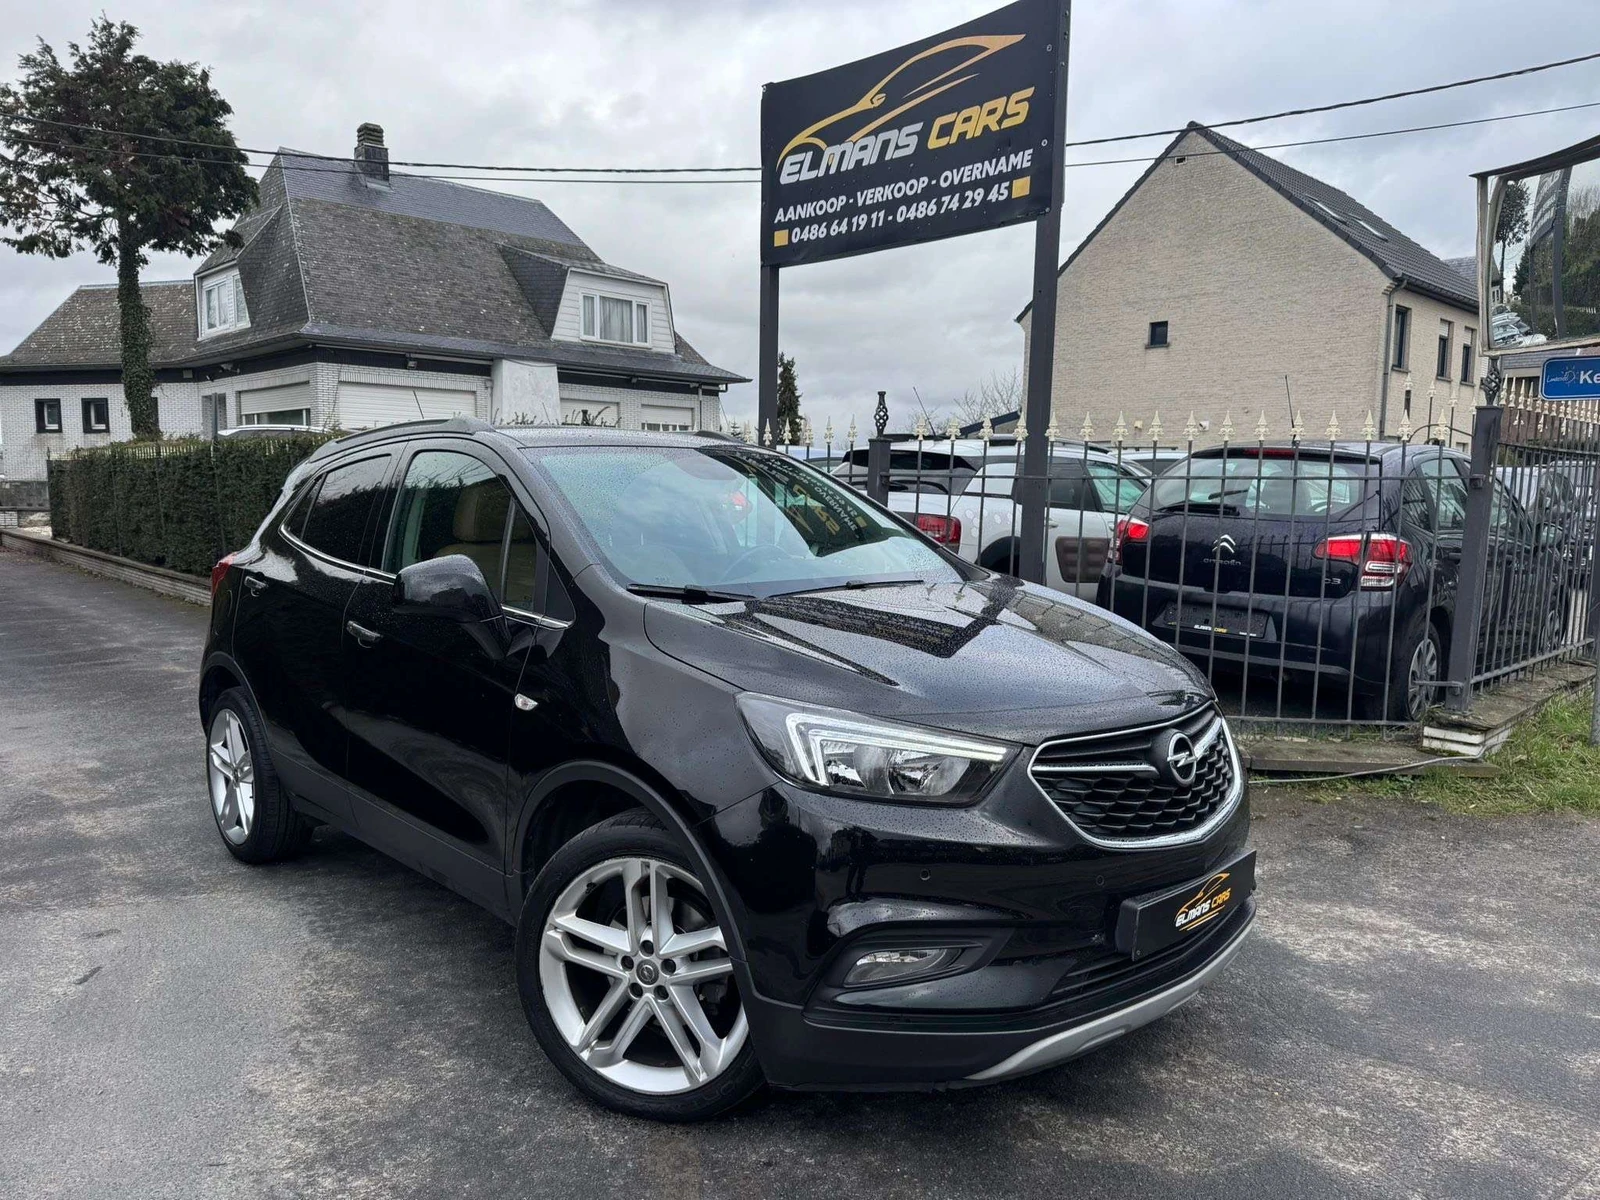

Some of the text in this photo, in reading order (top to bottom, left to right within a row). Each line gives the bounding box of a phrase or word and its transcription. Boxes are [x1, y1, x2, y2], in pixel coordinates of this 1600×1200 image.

[780, 86, 1035, 184] ELMANS CARS
[774, 195, 846, 223] AANKOOP
[857, 176, 928, 207] VERKOOP
[940, 148, 1033, 188] OVERNAME
[791, 222, 827, 243] 0486
[830, 217, 848, 236] 64
[851, 214, 867, 232] 19
[871, 210, 885, 228] 11
[896, 198, 937, 223] 0486
[940, 193, 960, 213] 74
[962, 188, 984, 209] 29
[987, 181, 1010, 202] 45
[1175, 888, 1231, 927] ELMANS CARS
